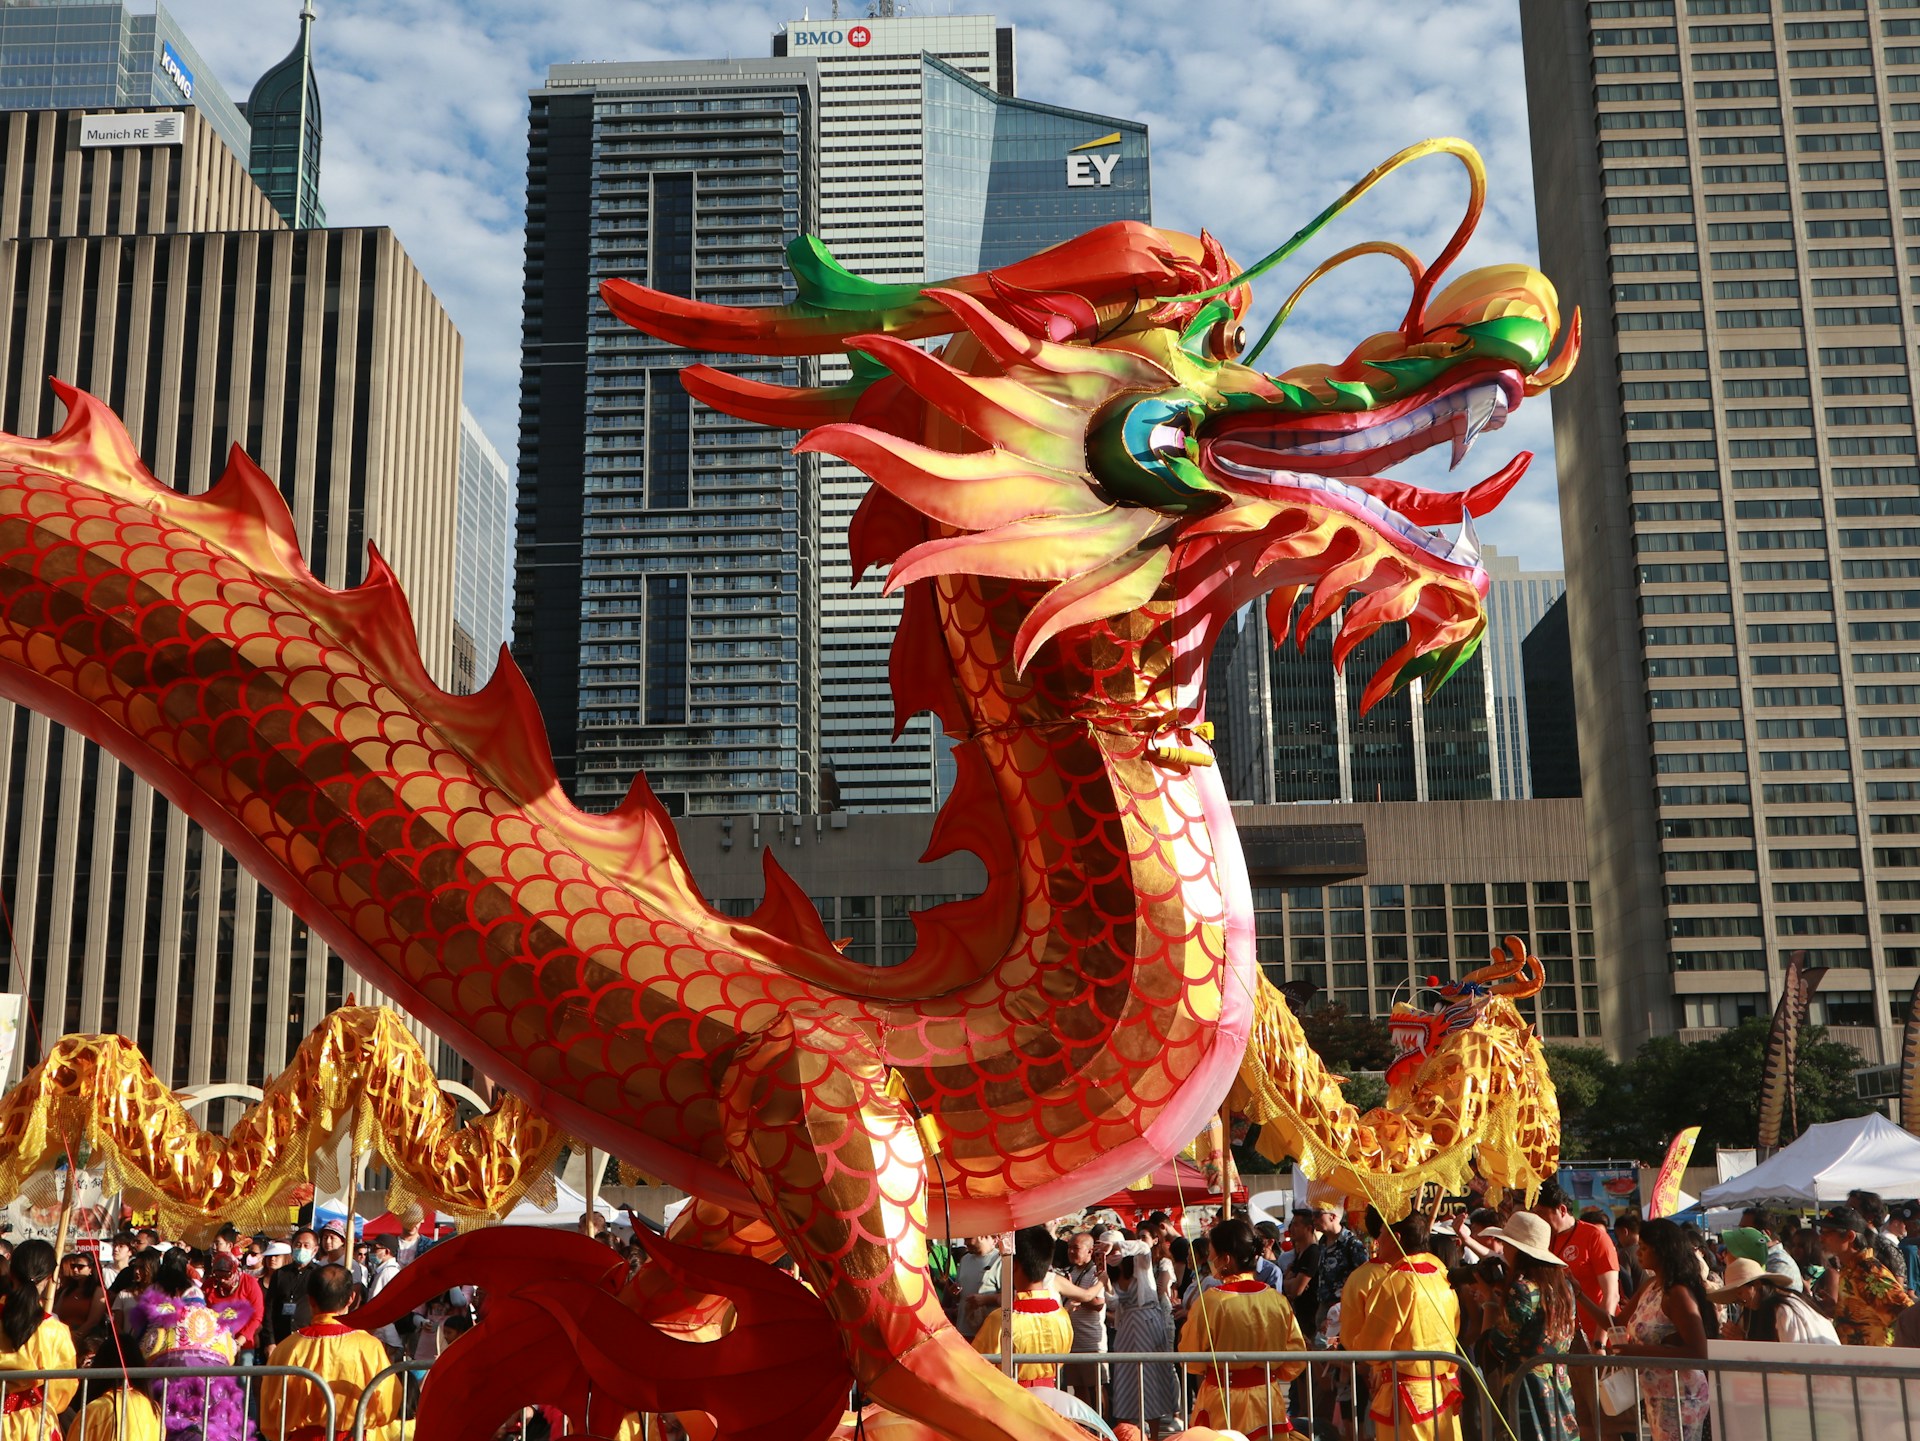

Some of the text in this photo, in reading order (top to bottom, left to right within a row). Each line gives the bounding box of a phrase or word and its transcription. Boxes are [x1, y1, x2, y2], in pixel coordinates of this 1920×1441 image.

[794, 30, 844, 46] BMO
[161, 51, 192, 99] KPMG
[87, 128, 150, 140] Munich RE
[1066, 153, 1121, 186] EY
